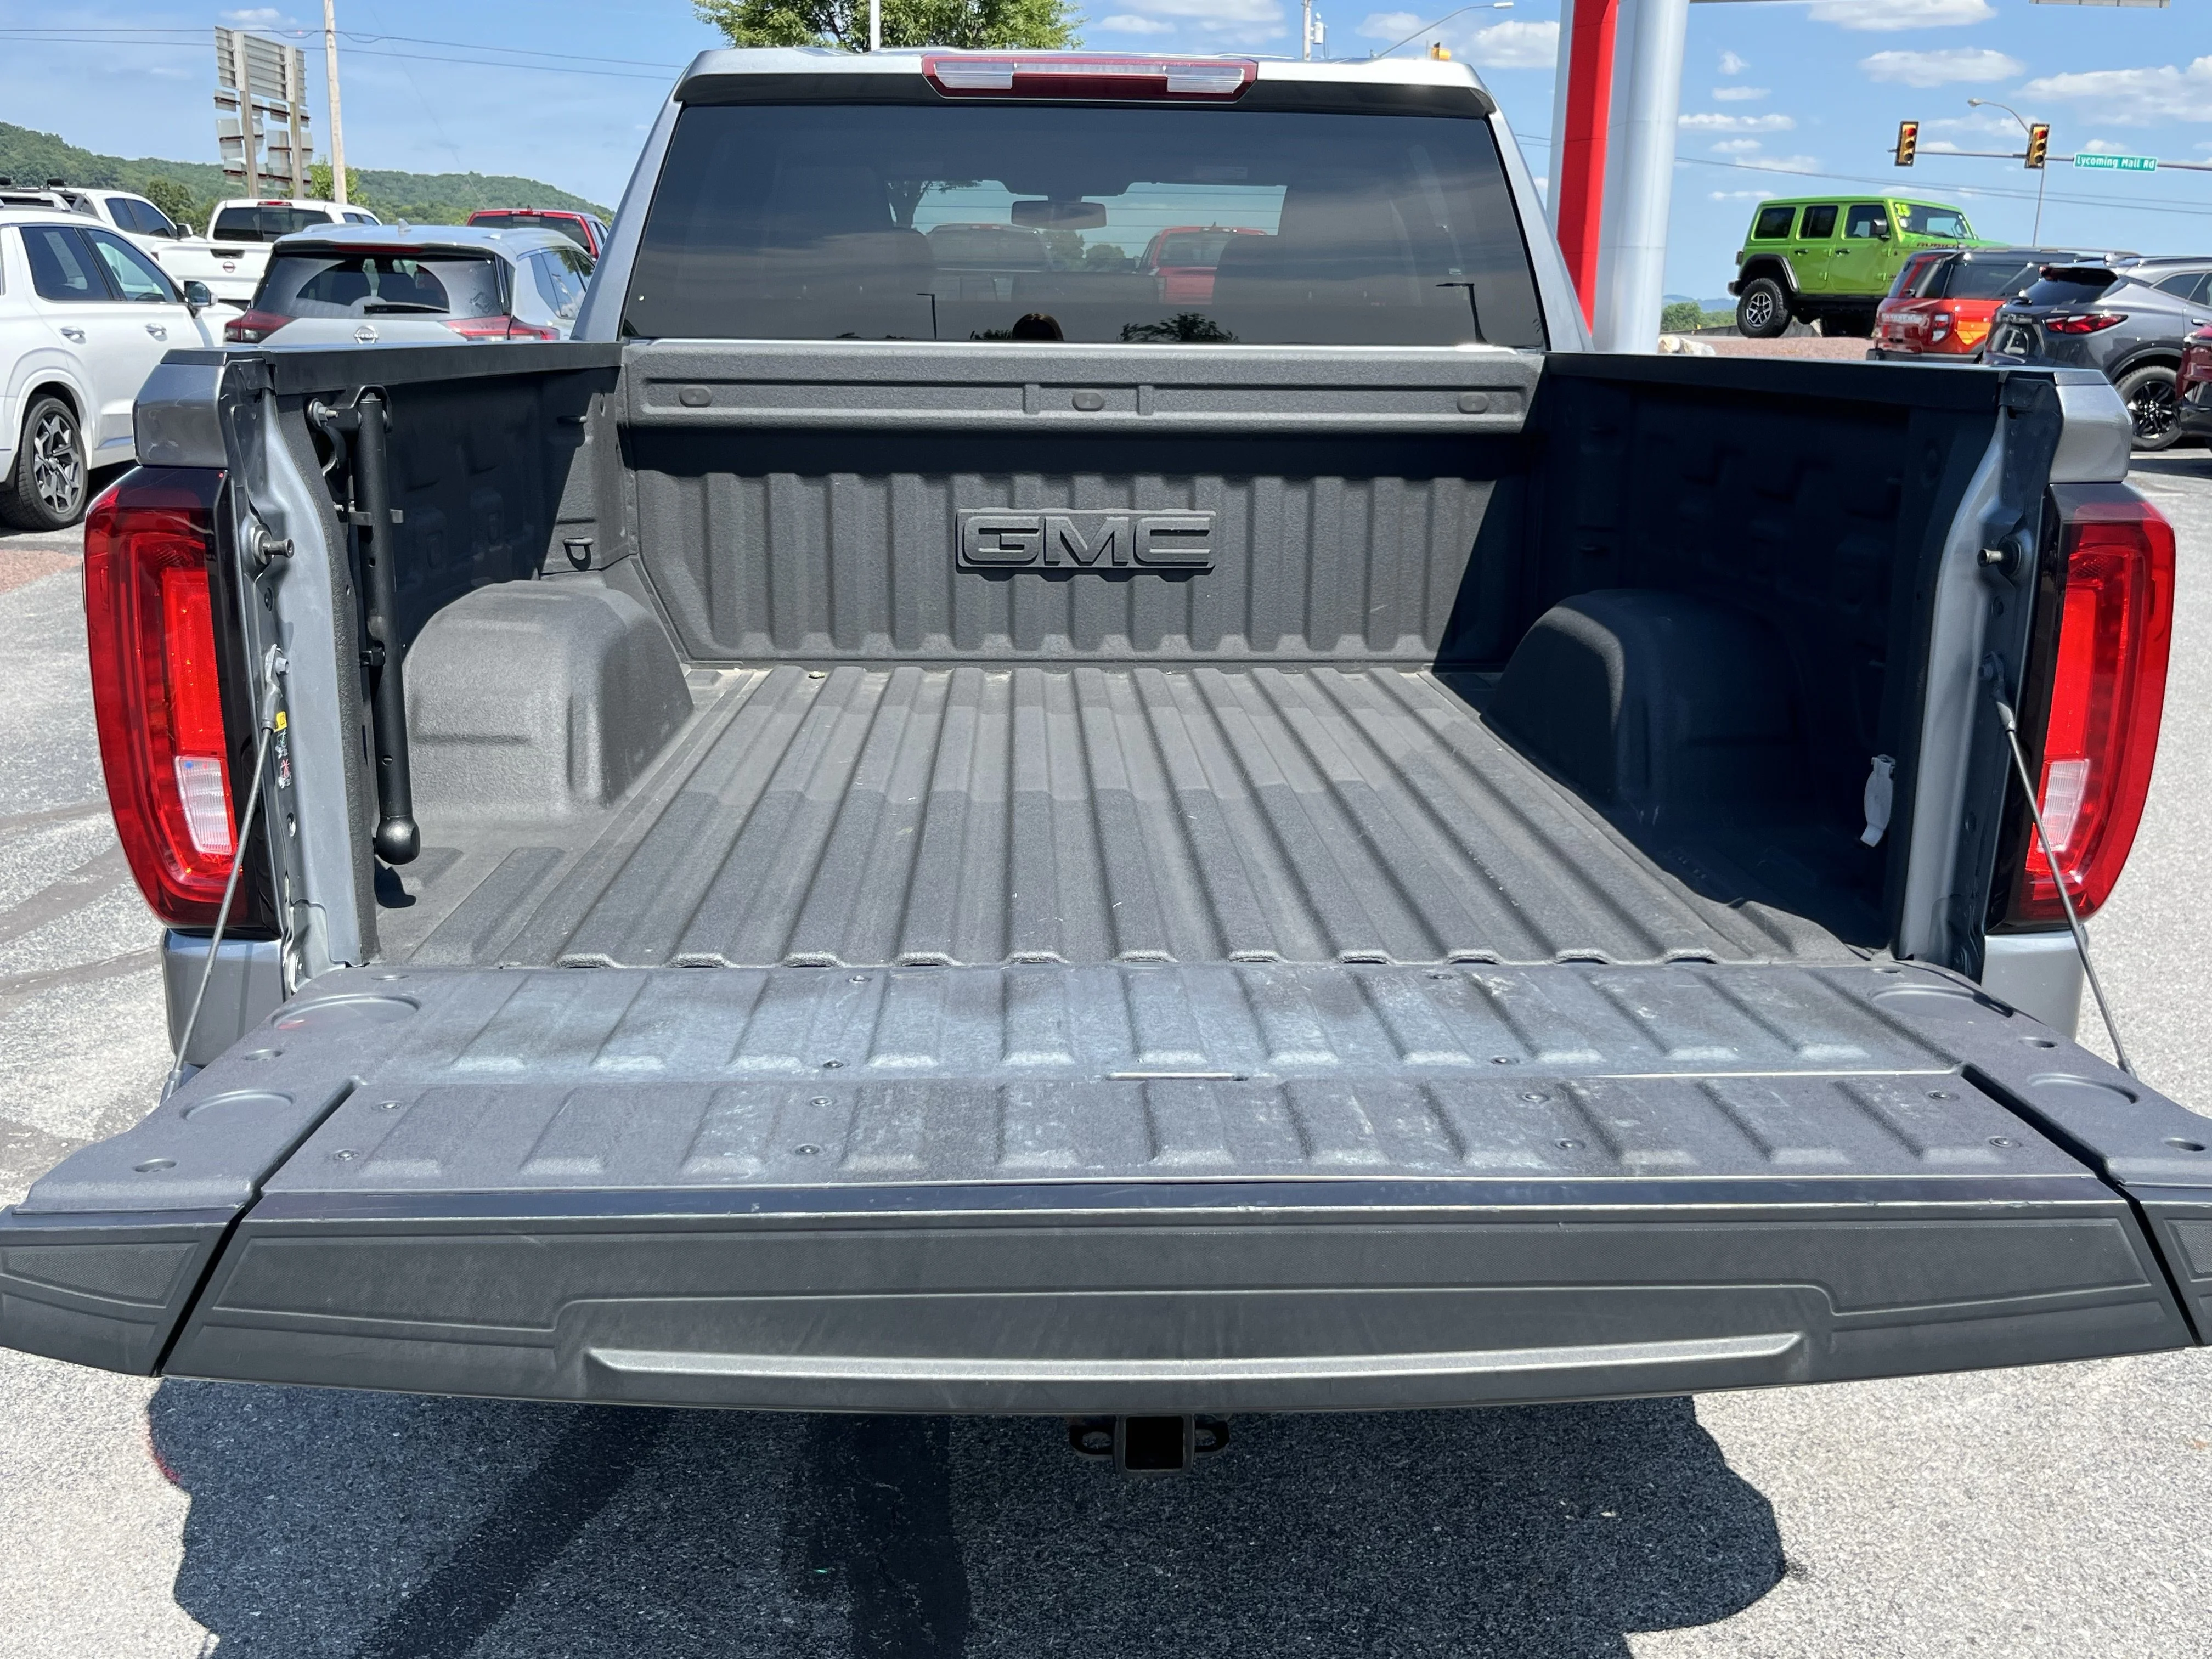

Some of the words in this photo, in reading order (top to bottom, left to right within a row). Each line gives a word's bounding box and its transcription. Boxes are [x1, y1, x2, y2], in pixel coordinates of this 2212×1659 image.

[2077, 156, 2118, 168] Lycoming
[2121, 158, 2140, 168] Mall
[2143, 159, 2154, 169] Rd
[963, 515, 1211, 566] GMC
